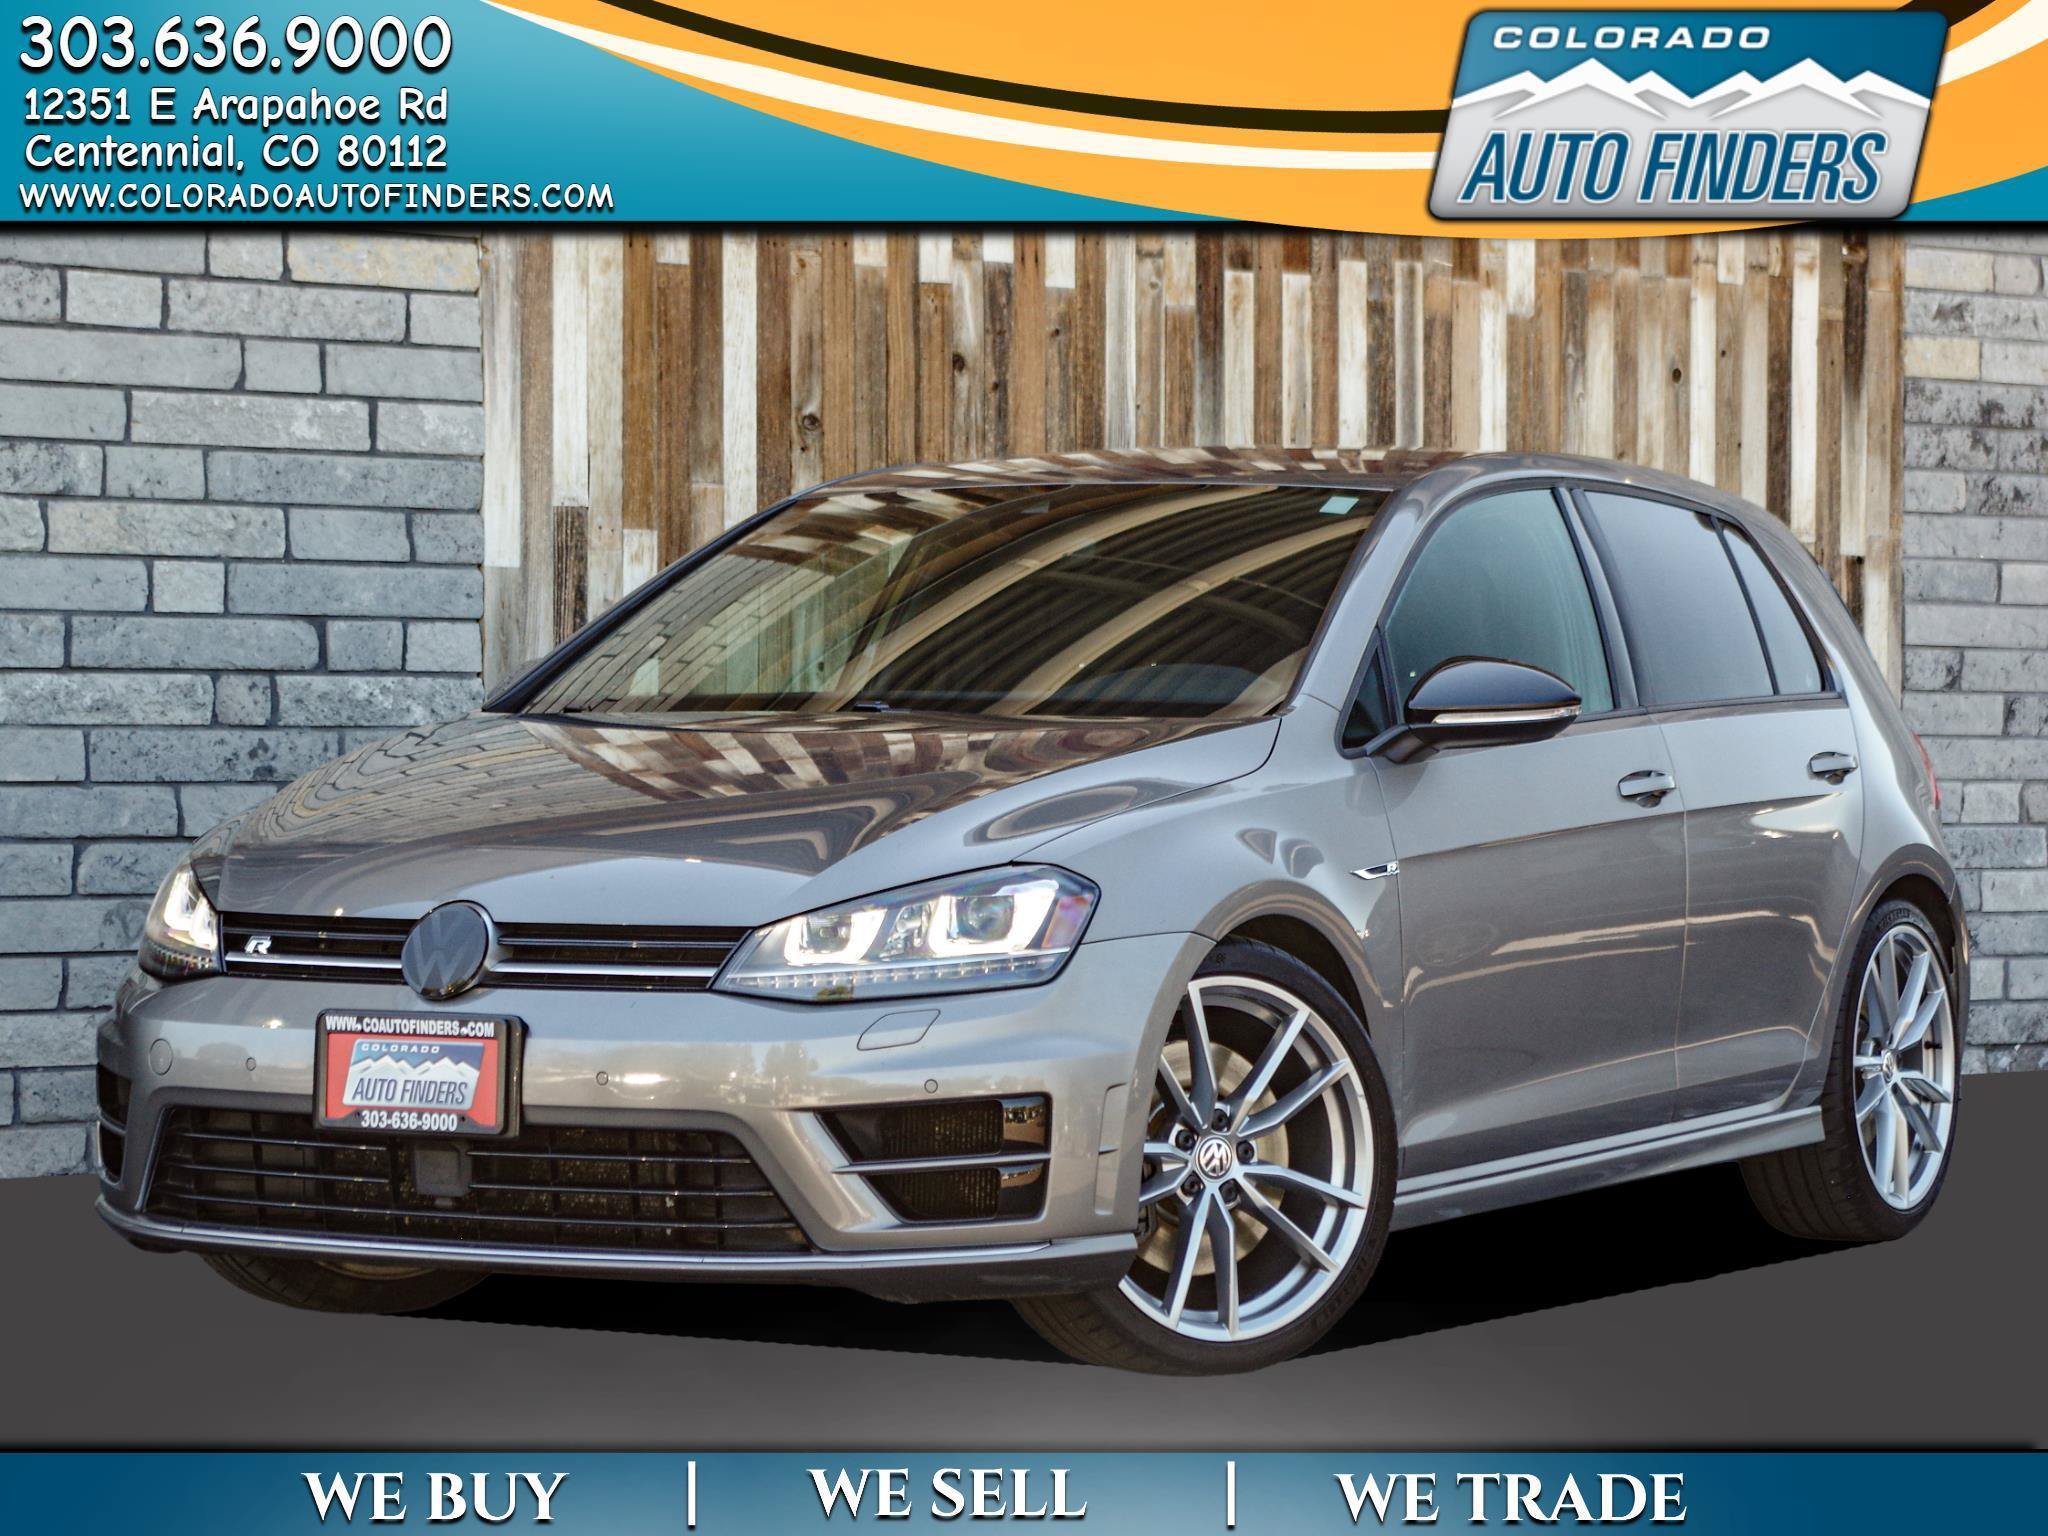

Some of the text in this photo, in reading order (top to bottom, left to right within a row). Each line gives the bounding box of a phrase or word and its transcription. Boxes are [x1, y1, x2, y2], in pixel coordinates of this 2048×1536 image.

[244, 935, 273, 955] R
[325, 1015, 495, 1037] WWW.COAUTOFINDERS.COM
[360, 1042, 441, 1054] COLORADO
[351, 1077, 468, 1105] AUTO FINDERS
[360, 1109, 458, 1132] 303-636-9000
